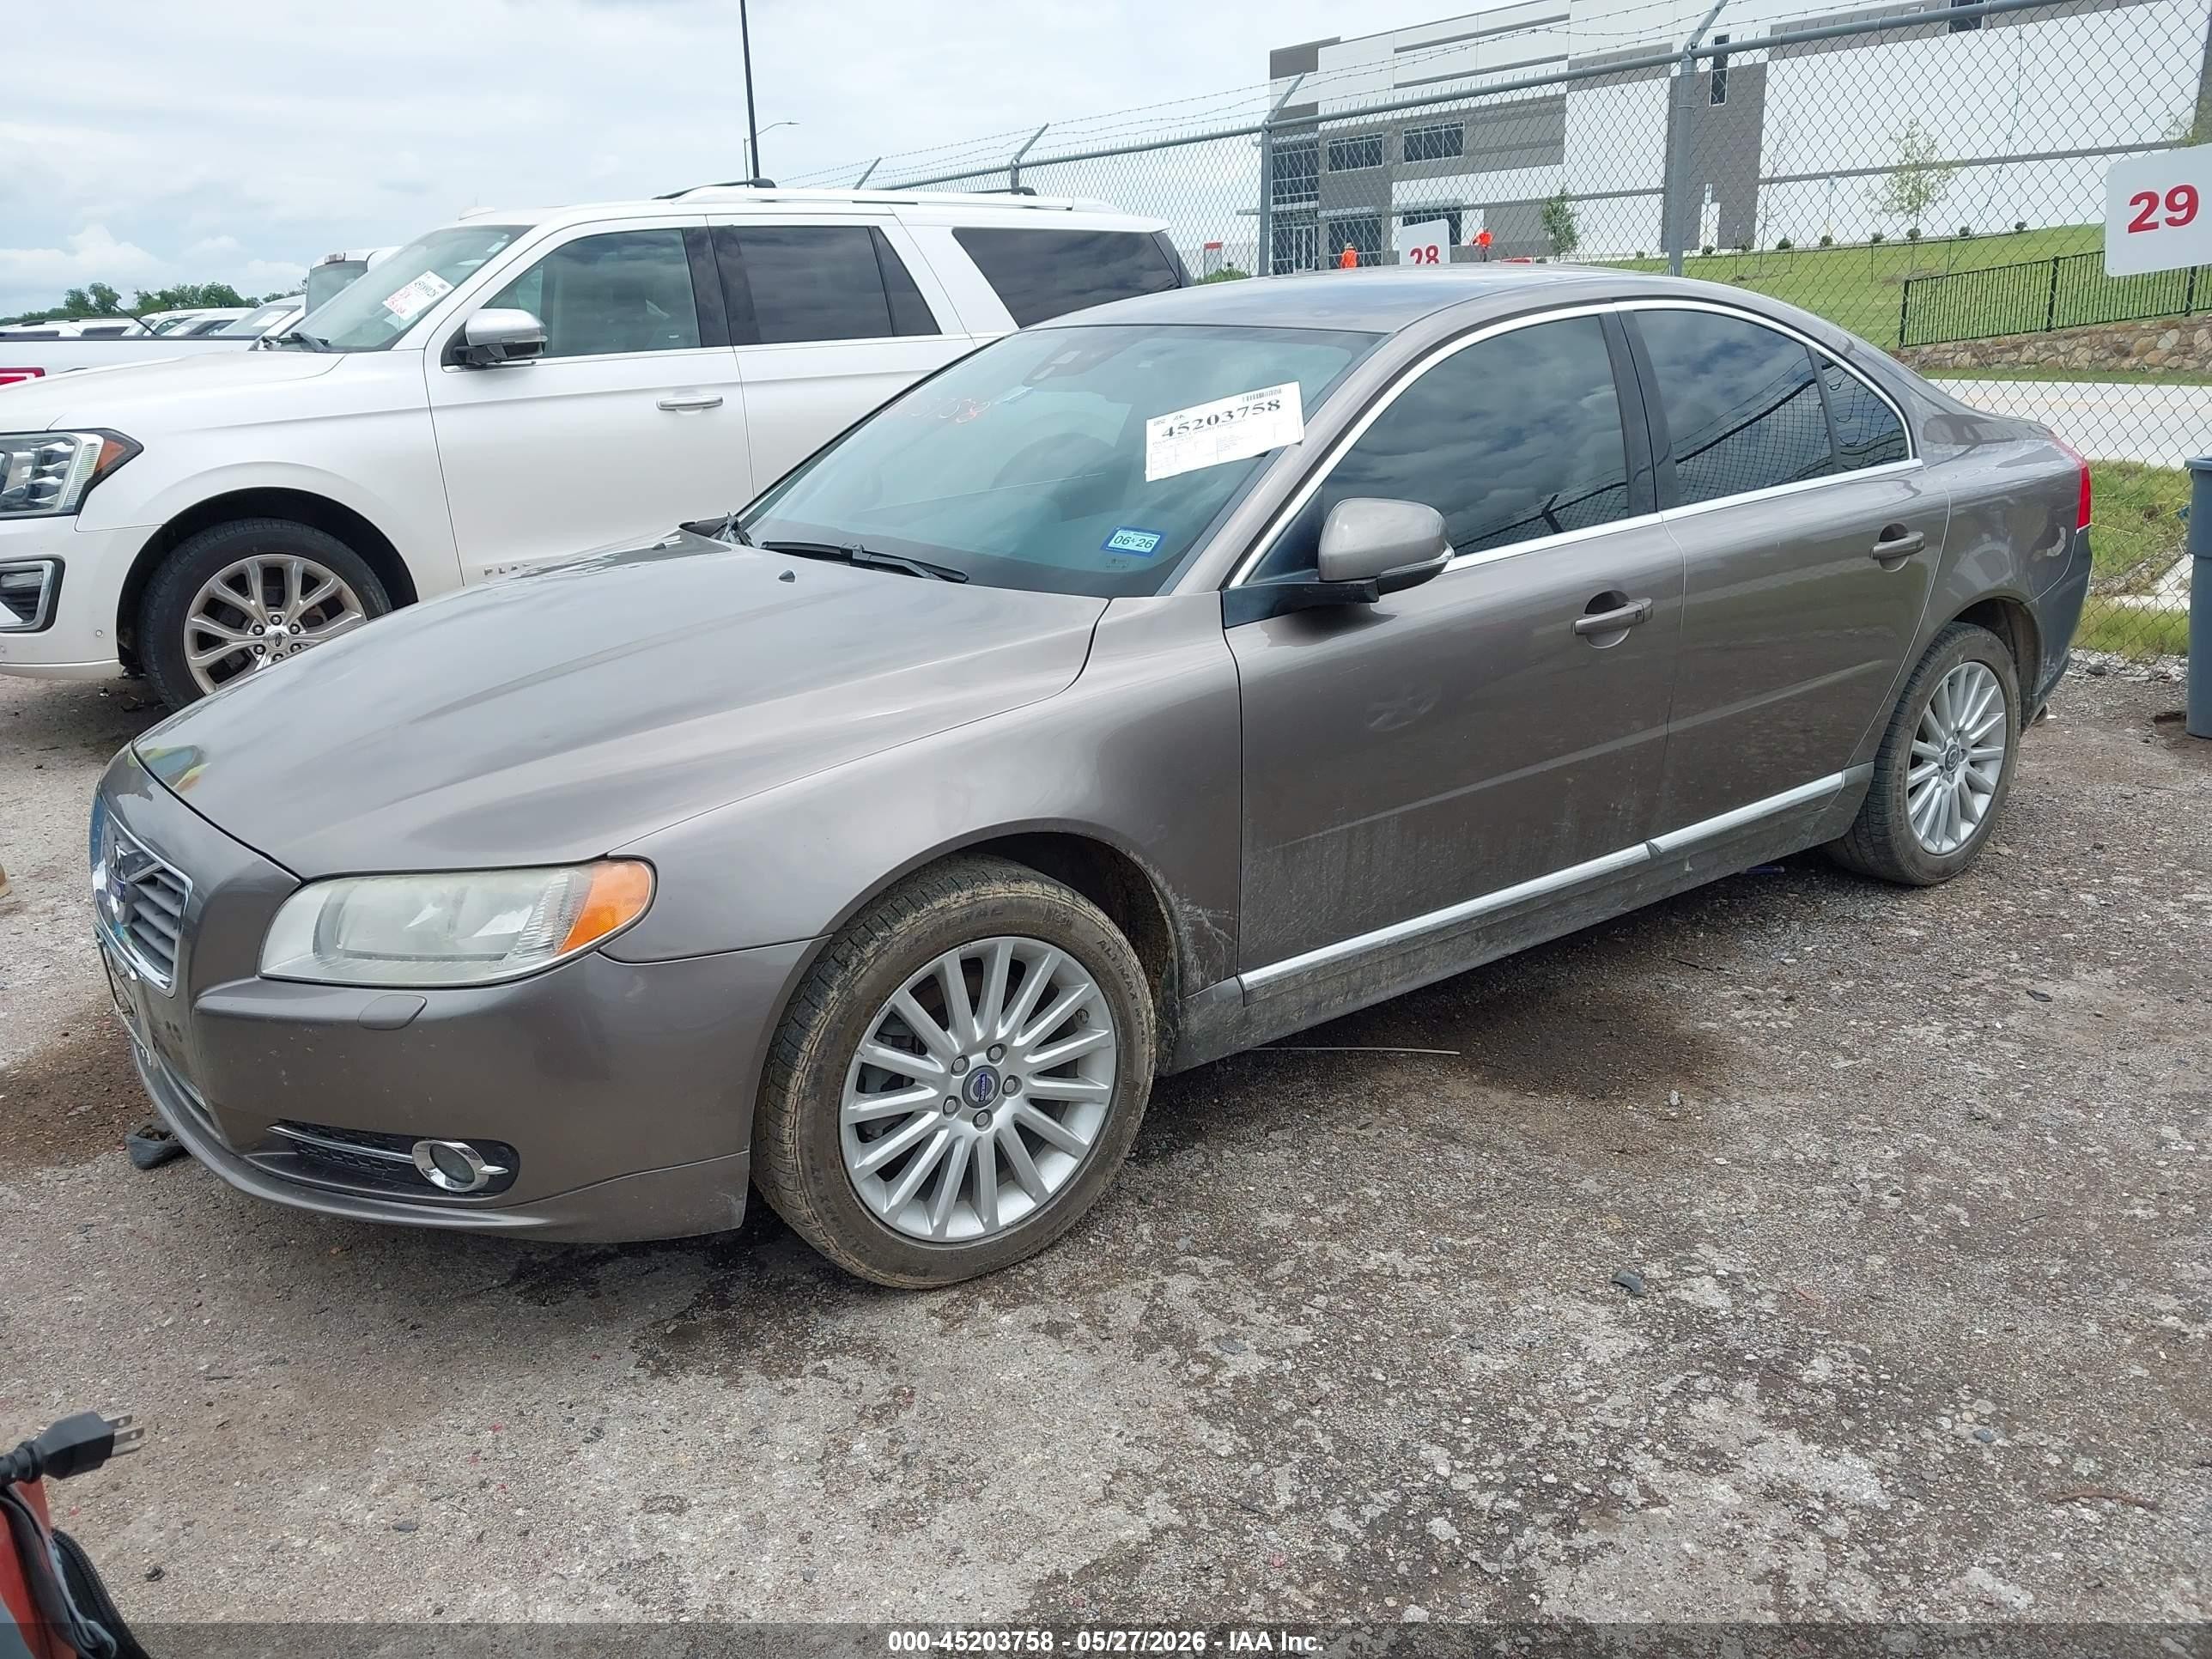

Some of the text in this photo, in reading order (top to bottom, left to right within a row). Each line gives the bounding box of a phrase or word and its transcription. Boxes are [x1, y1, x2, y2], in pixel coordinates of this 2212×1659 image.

[2128, 184, 2199, 234] 29
[1161, 398, 1281, 440] 45203758
[1113, 535, 1155, 549] 06 26
